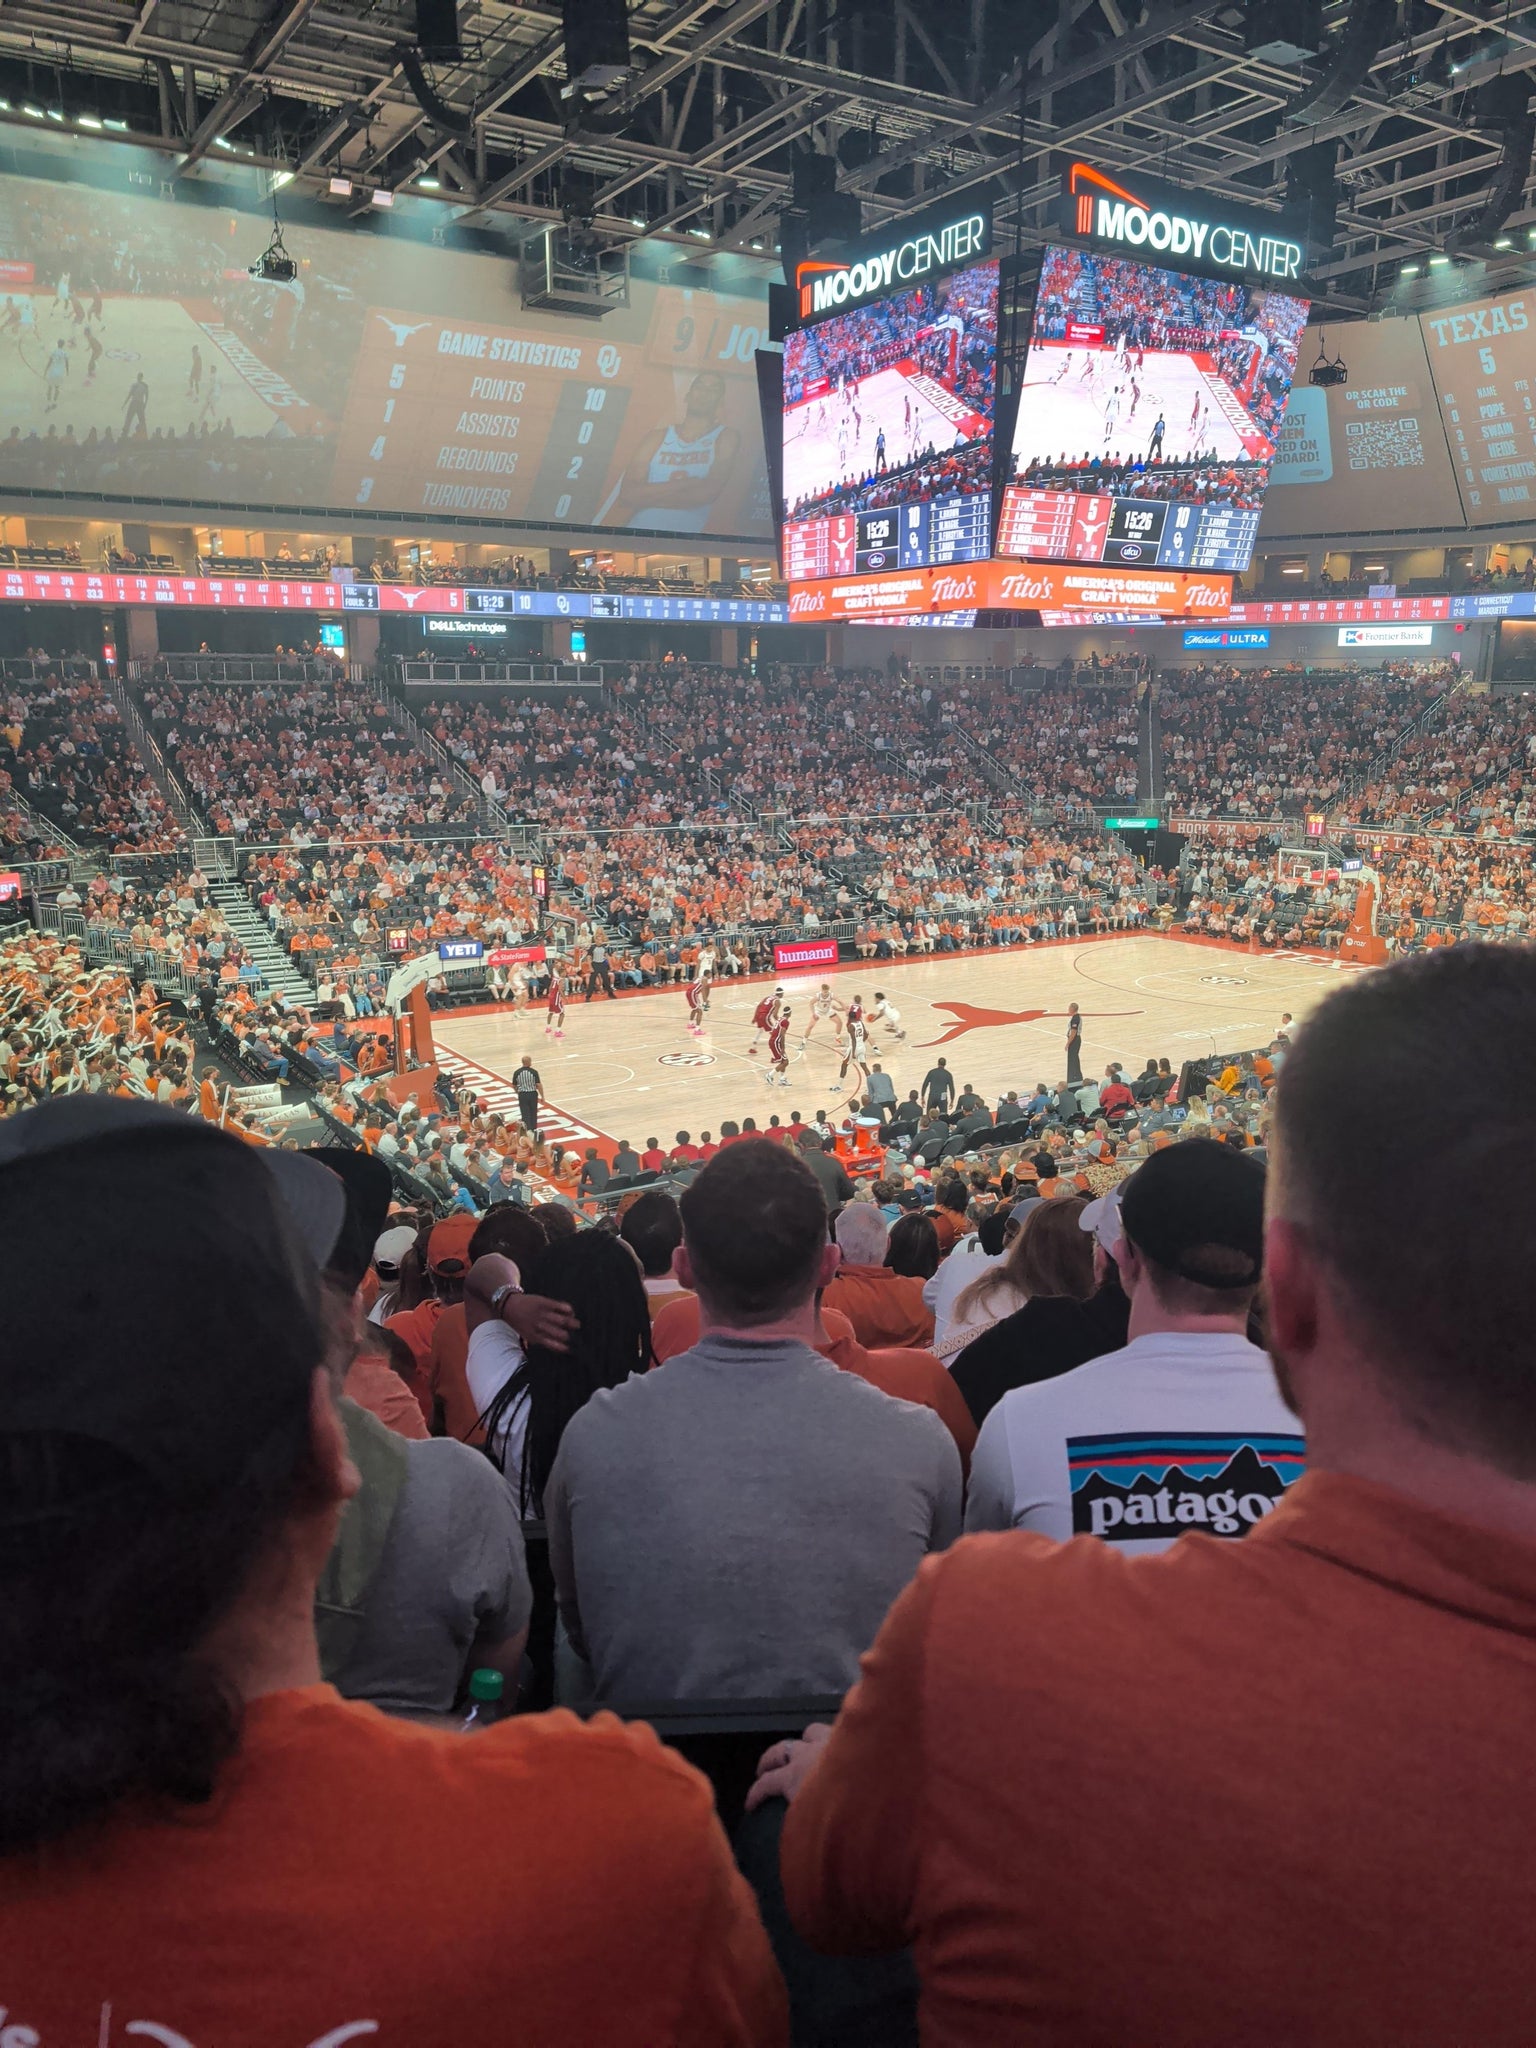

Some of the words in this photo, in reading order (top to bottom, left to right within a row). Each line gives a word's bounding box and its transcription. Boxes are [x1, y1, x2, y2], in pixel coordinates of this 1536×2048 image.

[1098, 199, 1208, 258] MOODY
[1209, 226, 1301, 280] CENTER
[813, 249, 899, 312] MOODY
[897, 215, 984, 280] CENTER
[1430, 302, 1529, 347] TEXAS
[672, 316, 695, 353] 9
[718, 323, 769, 362] JO
[438, 330, 489, 358] GAME
[489, 337, 581, 370] STATISTICS
[1478, 347, 1497, 375] 5
[389, 363, 405, 389] 5
[470, 376, 526, 403] POINTS
[584, 388, 606, 411] 10
[1346, 391, 1361, 400] OR
[1362, 389, 1388, 398] SCAN
[1388, 386, 1408, 397] THE
[1477, 385, 1498, 399] NAME
[1514, 379, 1529, 392] PTS
[907, 371, 976, 422] LONGHORNS
[1201, 371, 1263, 438] LONGHORNS
[1373, 397, 1399, 407] CODE
[1451, 409, 1459, 423] 0
[1479, 403, 1506, 419] POPE
[1523, 397, 1532, 410] 3
[383, 399, 395, 423] 1
[456, 411, 520, 438] ASSISTS
[578, 421, 594, 445] 0
[1481, 422, 1514, 441] SWAIN
[1300, 440, 1317, 450] ON
[369, 436, 386, 461] 4
[436, 447, 518, 474] REBOUNDS
[566, 456, 583, 479] 2
[357, 478, 375, 504] 3
[422, 482, 512, 512] TURNOVERS
[555, 495, 572, 518] 0
[908, 506, 920, 529] 10
[1087, 498, 1100, 521] 5
[1175, 507, 1190, 528] 10
[838, 518, 846, 540] 5
[1124, 510, 1143, 531] 15:26
[832, 584, 879, 597] AMERICA'S
[879, 579, 924, 594] ORIGINAL
[931, 575, 976, 602] Tito's
[1000, 573, 1053, 600] Tito's
[1064, 576, 1125, 590] AMERICA'S
[1125, 580, 1176, 593] ORIGINAL
[368, 599, 374, 608] 2
[450, 592, 457, 607] 5
[477, 595, 504, 608] 15:26
[520, 594, 531, 610] 10
[792, 590, 825, 613] Tito's
[845, 597, 872, 609] CRAFT
[1081, 590, 1119, 603] CRAFT
[1184, 583, 1229, 608] Tito's
[1479, 596, 1513, 606] CONNECTICUT
[1478, 606, 1508, 615] MARQUETTE
[429, 620, 456, 631] DELL
[455, 620, 507, 634] Technologies
[1365, 632, 1399, 641] Frontier
[1400, 631, 1424, 641] Bank
[1230, 635, 1267, 644] ULTRA
[1177, 822, 1209, 834] HOOK
[1311, 823, 1322, 834] 11
[1329, 831, 1389, 847] WECOME
[1345, 861, 1360, 870] YETI
[536, 879, 545, 894] 11
[393, 939, 404, 948] 11
[446, 944, 477, 956] YETI
[778, 948, 833, 963] humann
[855, 1028, 863, 1037] 12
